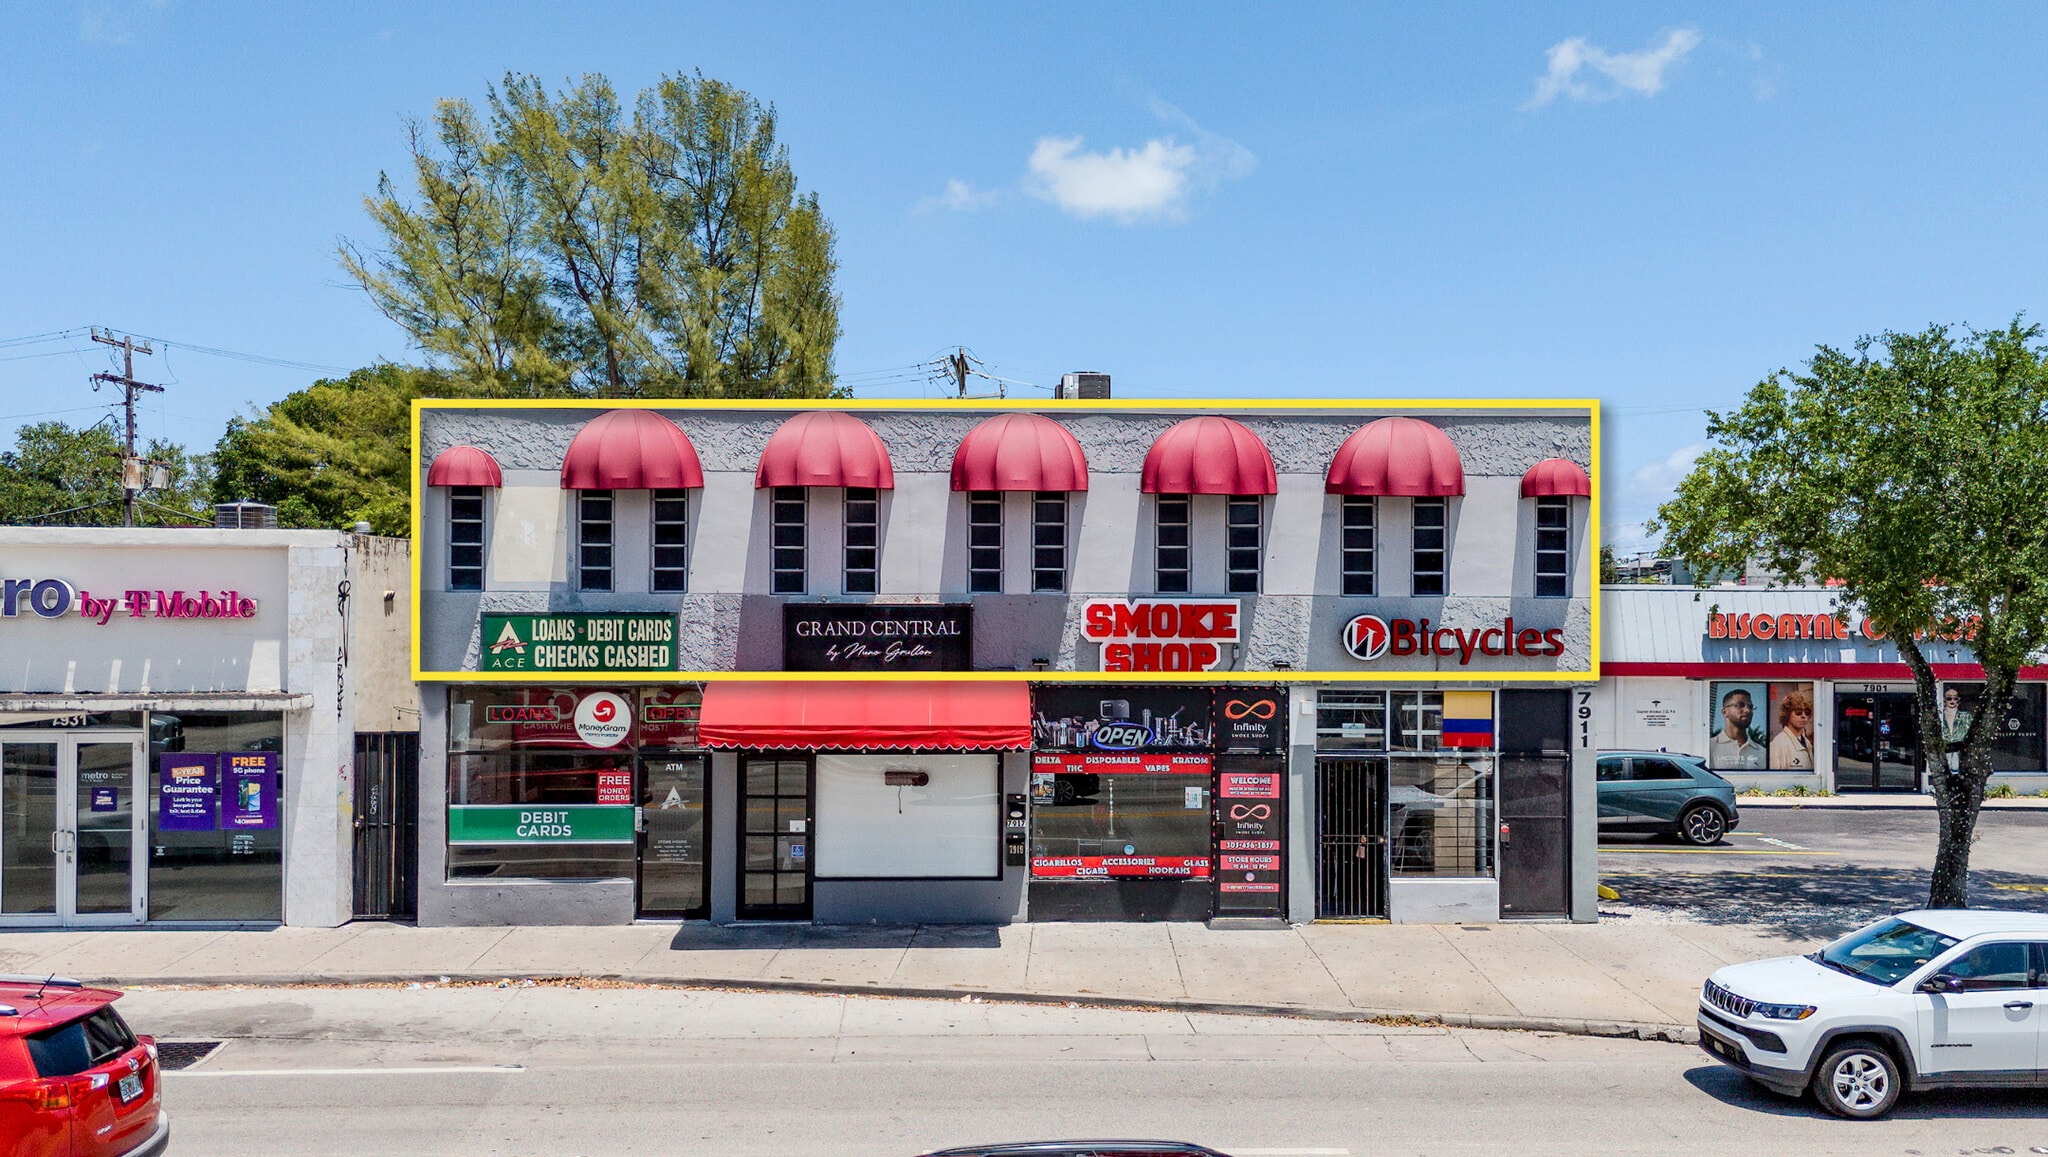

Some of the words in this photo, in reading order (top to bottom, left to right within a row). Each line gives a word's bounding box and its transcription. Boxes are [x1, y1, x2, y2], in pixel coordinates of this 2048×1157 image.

[80, 591, 117, 625] by
[1086, 603, 1237, 638] SMOKE
[1707, 613, 1849, 639] BISCAYNE
[532, 619, 575, 641] LOANS
[588, 619, 624, 641] DEBIT
[628, 619, 671, 641] CARDS
[796, 620, 866, 636] GRAND
[870, 620, 960, 636] CENTRAL
[1391, 617, 1564, 665] Bicycles
[534, 645, 599, 668] CHECKS
[604, 645, 670, 668] CASHED
[826, 644, 841, 661] by
[1105, 643, 1217, 672] SHOP
[491, 658, 525, 668] ACE
[1863, 684, 1888, 692] 7901
[491, 707, 556, 720] LOANS
[649, 707, 699, 720] OPEN
[1578, 692, 1591, 748] 7911
[1233, 722, 1267, 733] Infinity
[1097, 726, 1148, 746] OPEN
[232, 757, 266, 766] FREE
[1035, 756, 1061, 764] DELTA
[1086, 756, 1140, 764] DISPOSABLES
[1172, 756, 1208, 764] KRATOM
[665, 763, 683, 771] ATM
[176, 776, 201, 785] Price
[599, 775, 631, 785] FREE
[1230, 776, 1272, 784] WELCOME
[163, 785, 214, 793] Guarantee
[521, 812, 568, 824] DEBIT
[516, 825, 572, 837] CARDS
[1102, 858, 1155, 866] ACCESSORIES
[1183, 859, 1209, 867] GLASS
[1076, 867, 1108, 875] CIGARS
[1148, 867, 1190, 875] HOOKAHS
